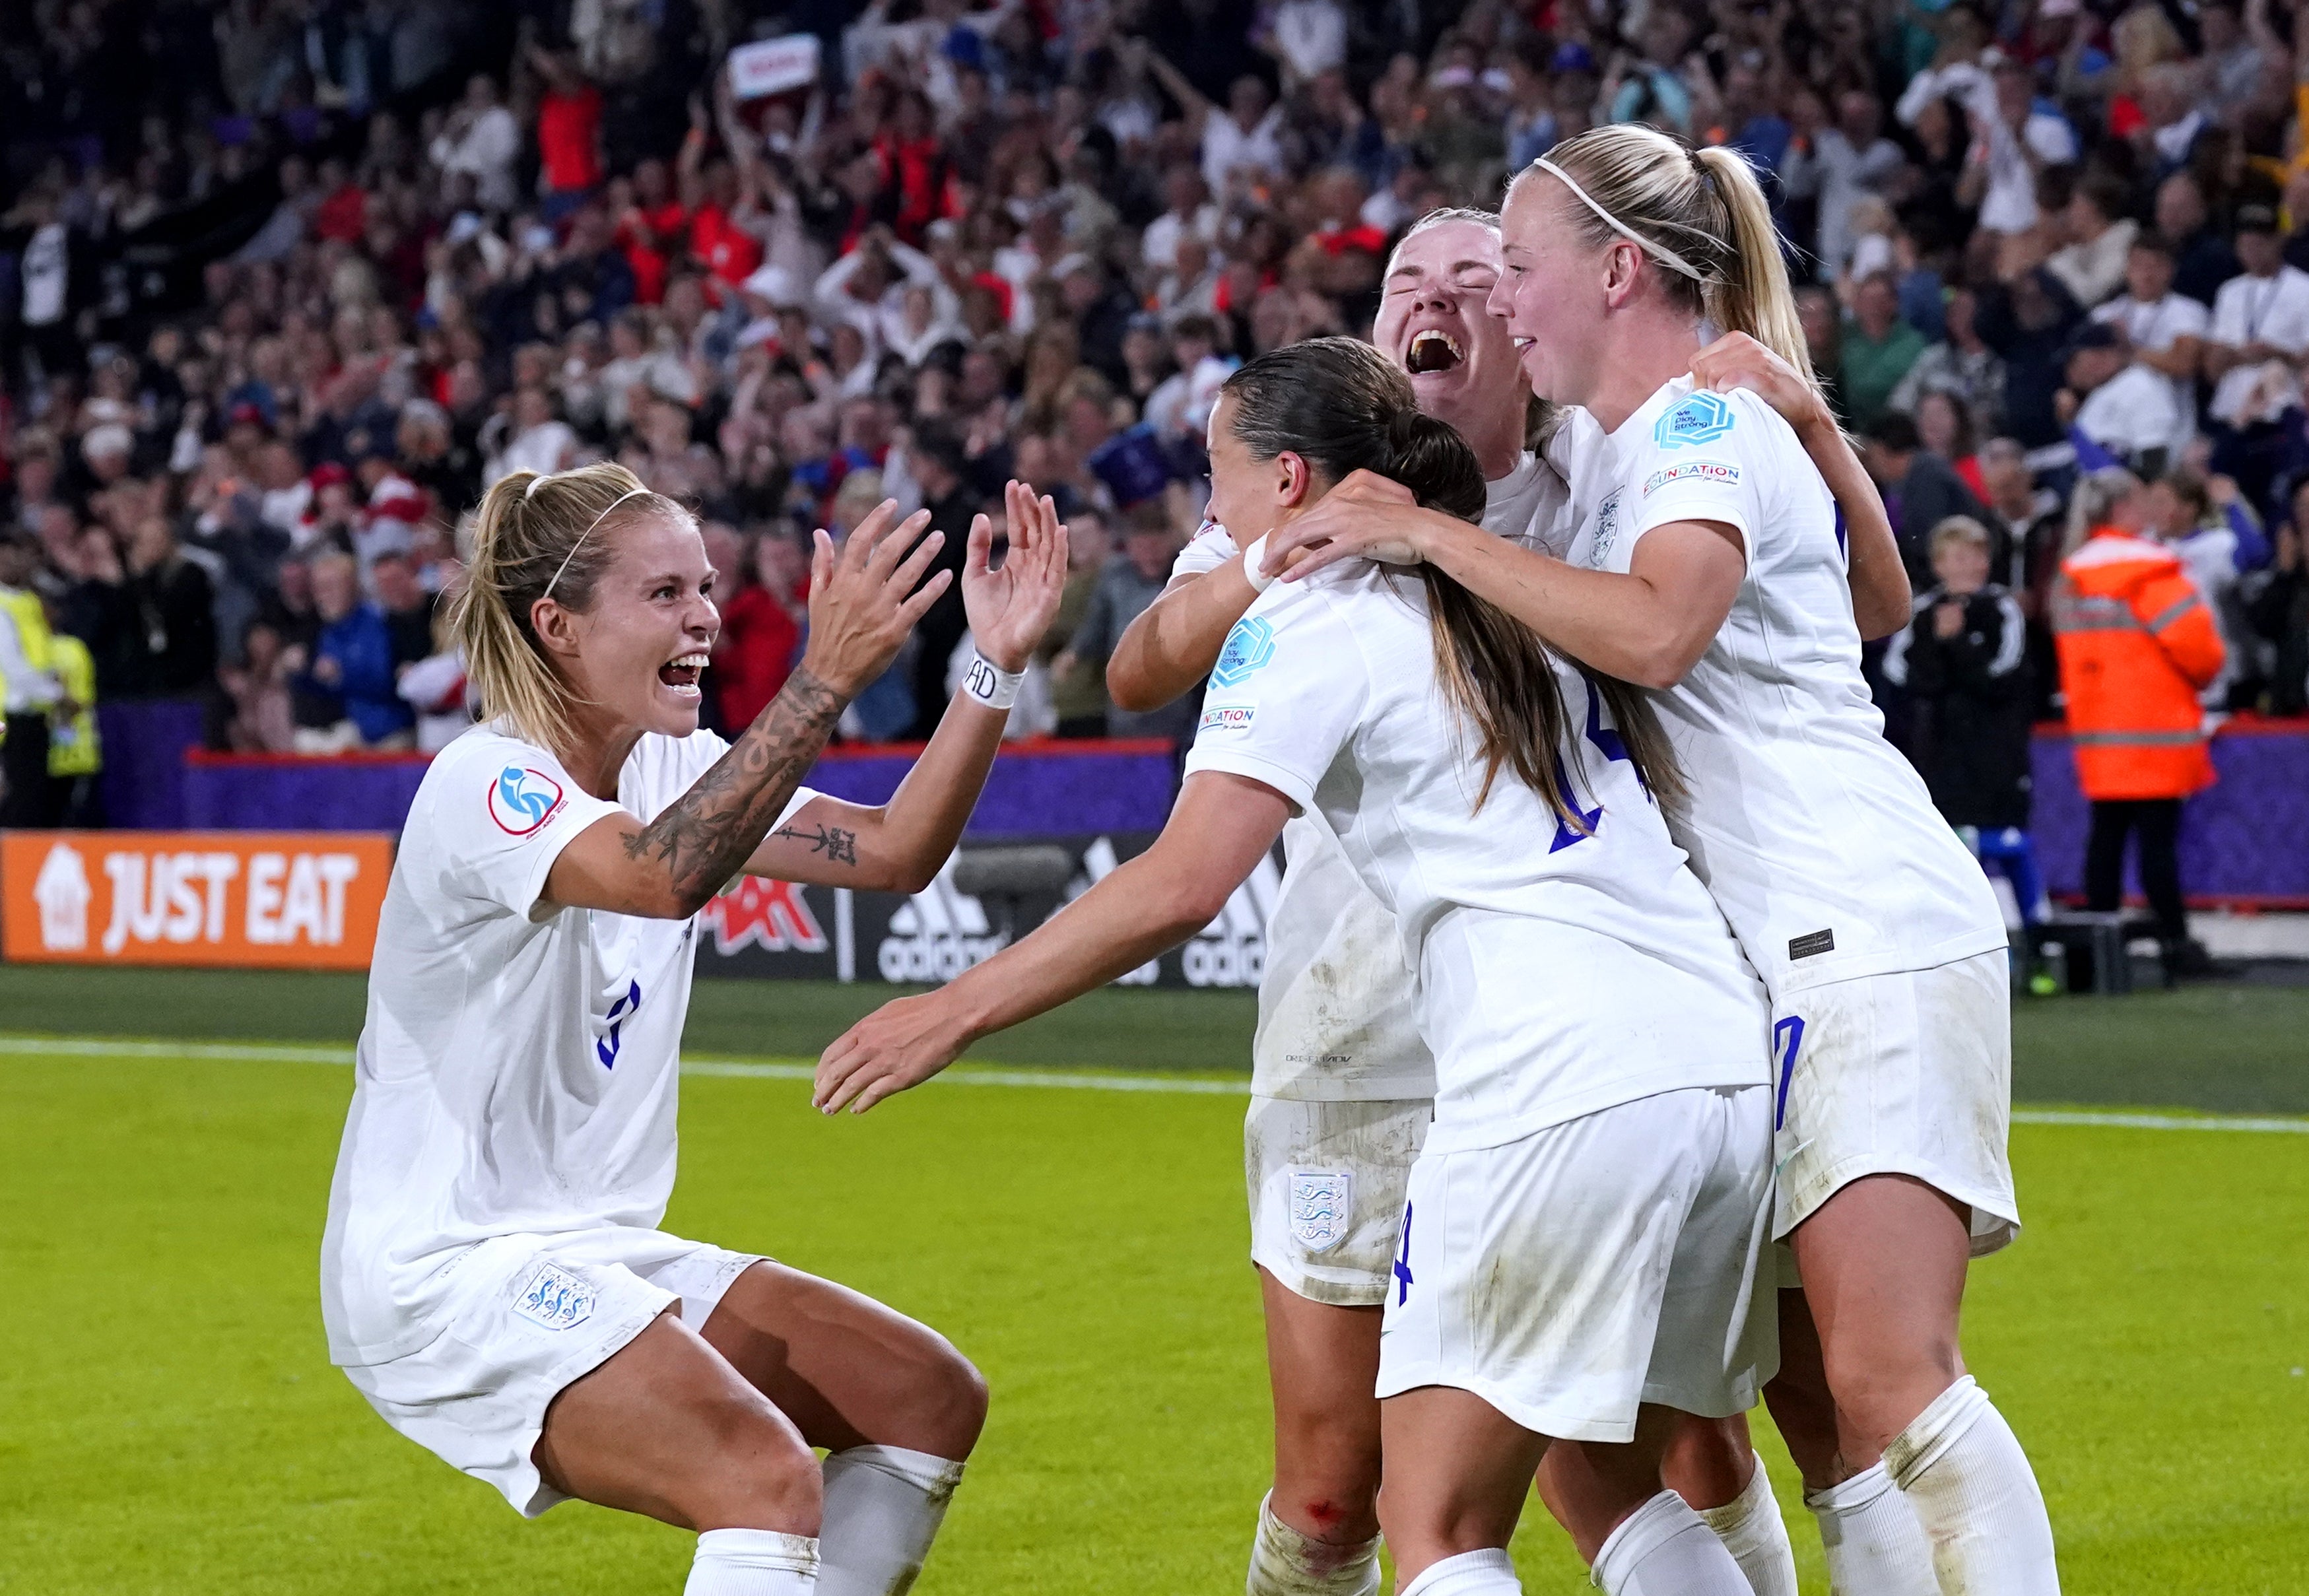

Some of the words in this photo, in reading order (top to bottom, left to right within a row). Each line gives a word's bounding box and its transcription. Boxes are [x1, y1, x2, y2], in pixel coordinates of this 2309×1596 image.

[965, 660, 996, 700] AD
[102, 851, 240, 956] JUST
[245, 851, 360, 946] EAT
[1774, 1014, 1806, 1133] 7
